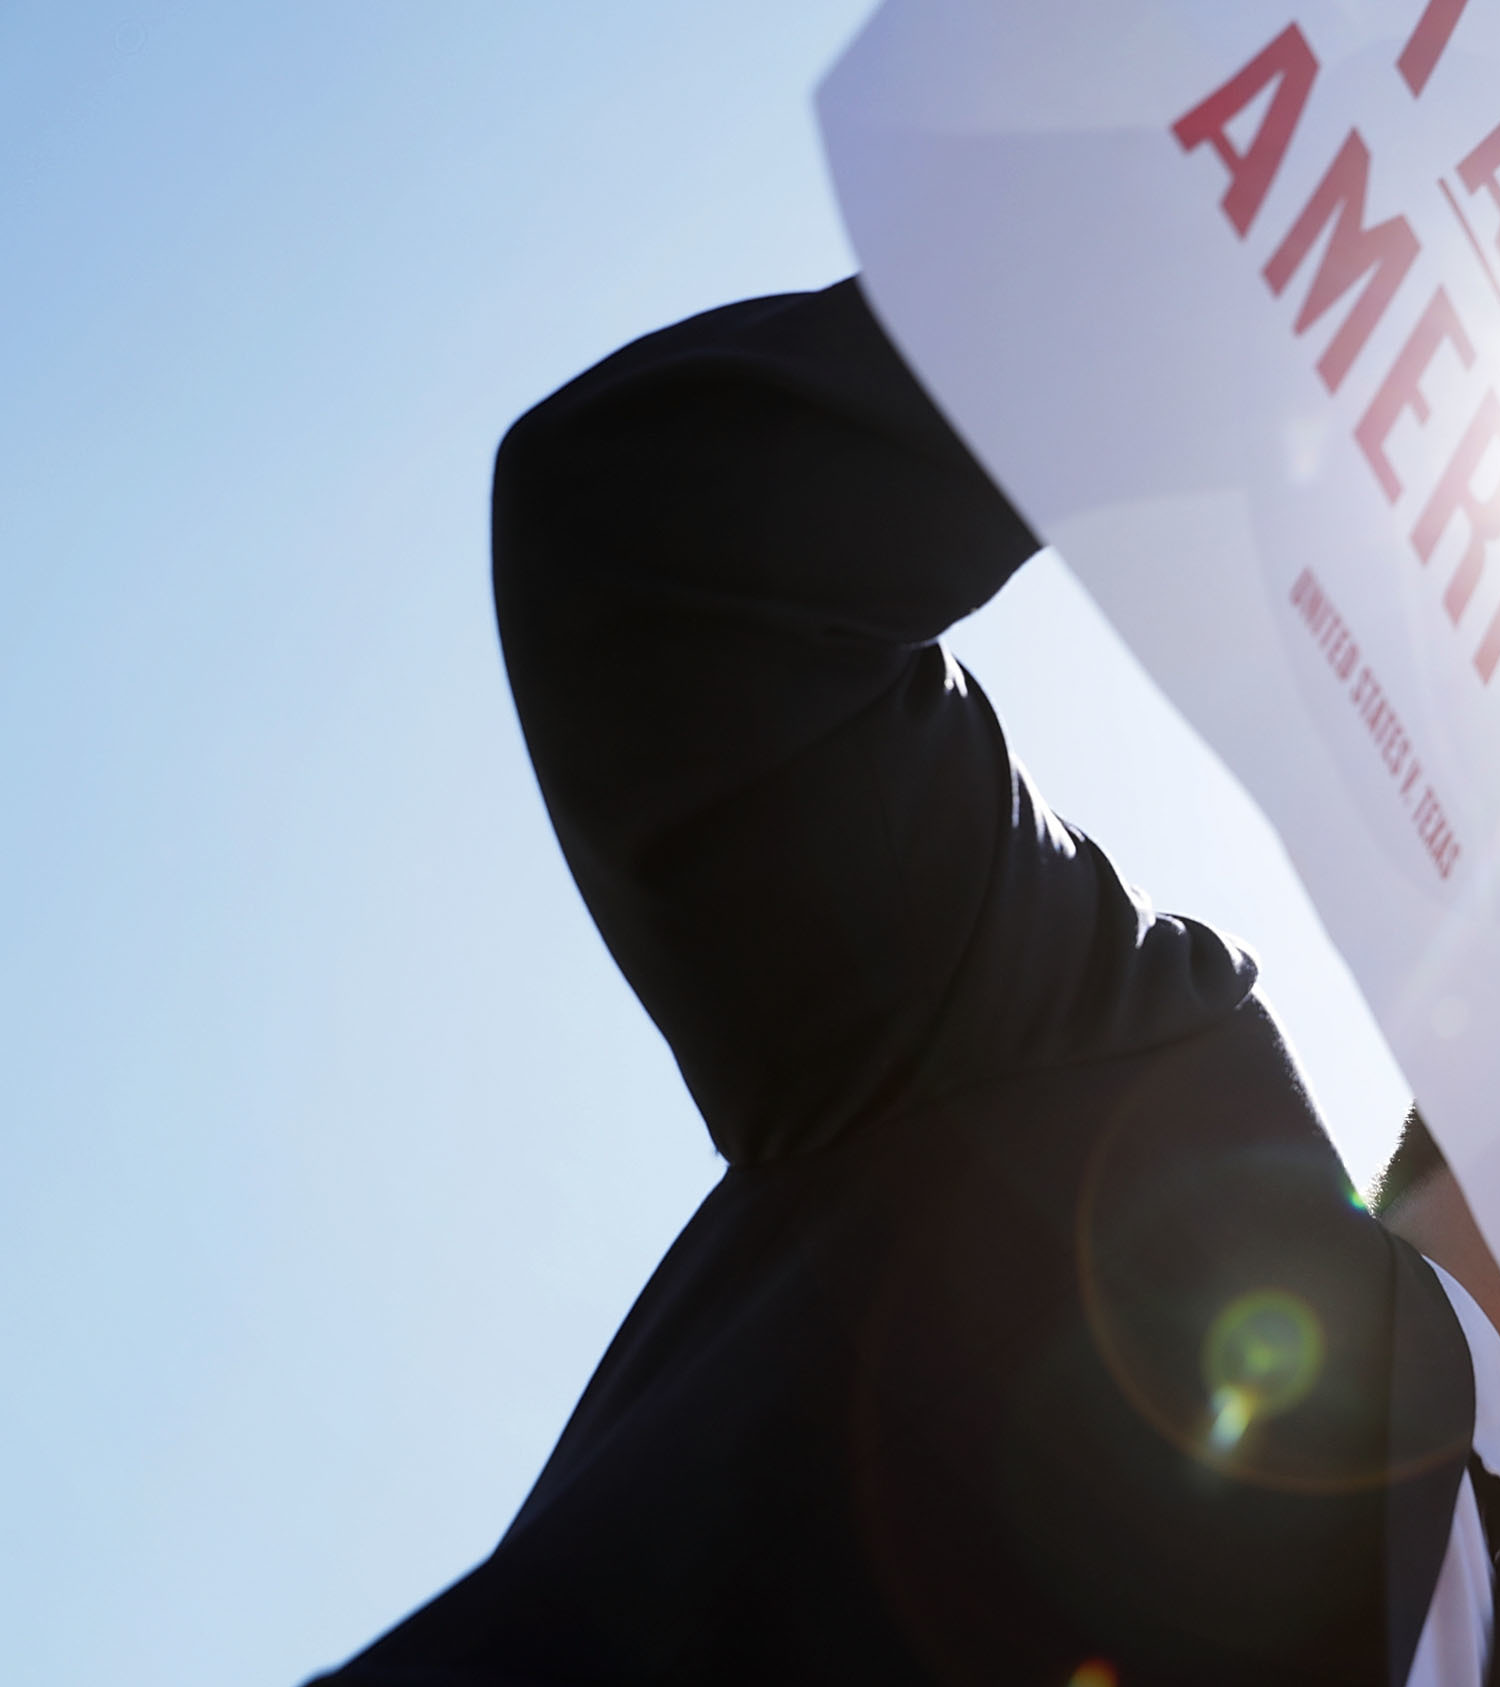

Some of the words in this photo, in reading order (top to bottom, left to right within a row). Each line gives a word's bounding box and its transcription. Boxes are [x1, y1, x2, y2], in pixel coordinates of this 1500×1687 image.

[1289, 564, 1359, 682] UNITED
[1350, 665, 1412, 777] STATES
[1411, 785, 1463, 881] TEXAS
